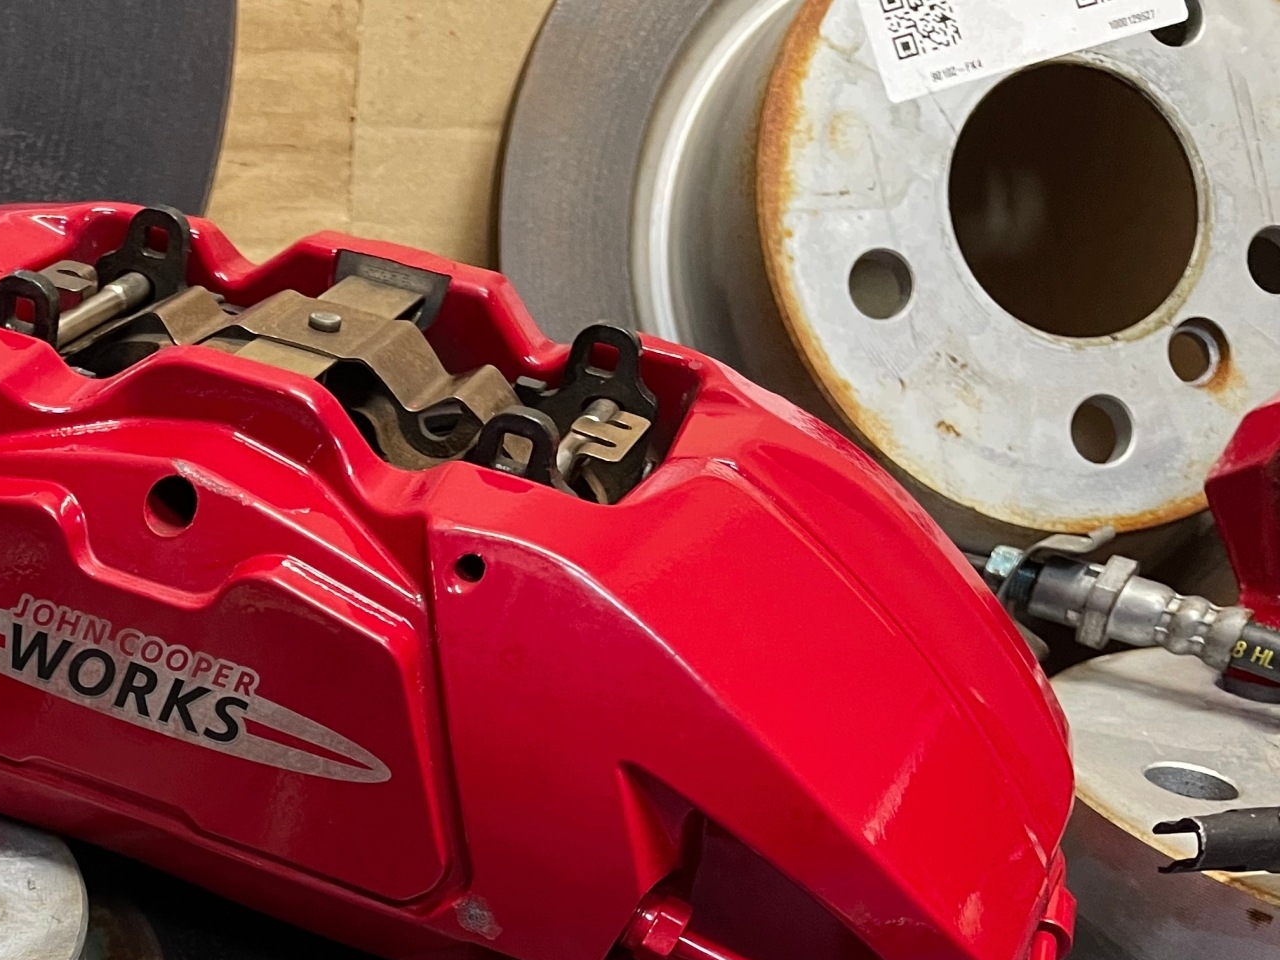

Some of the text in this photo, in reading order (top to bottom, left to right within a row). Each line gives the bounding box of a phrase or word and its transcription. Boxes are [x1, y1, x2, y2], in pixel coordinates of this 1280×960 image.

[11, 623, 249, 742] WORKS
[13, 598, 256, 697] JOHN COOPER
